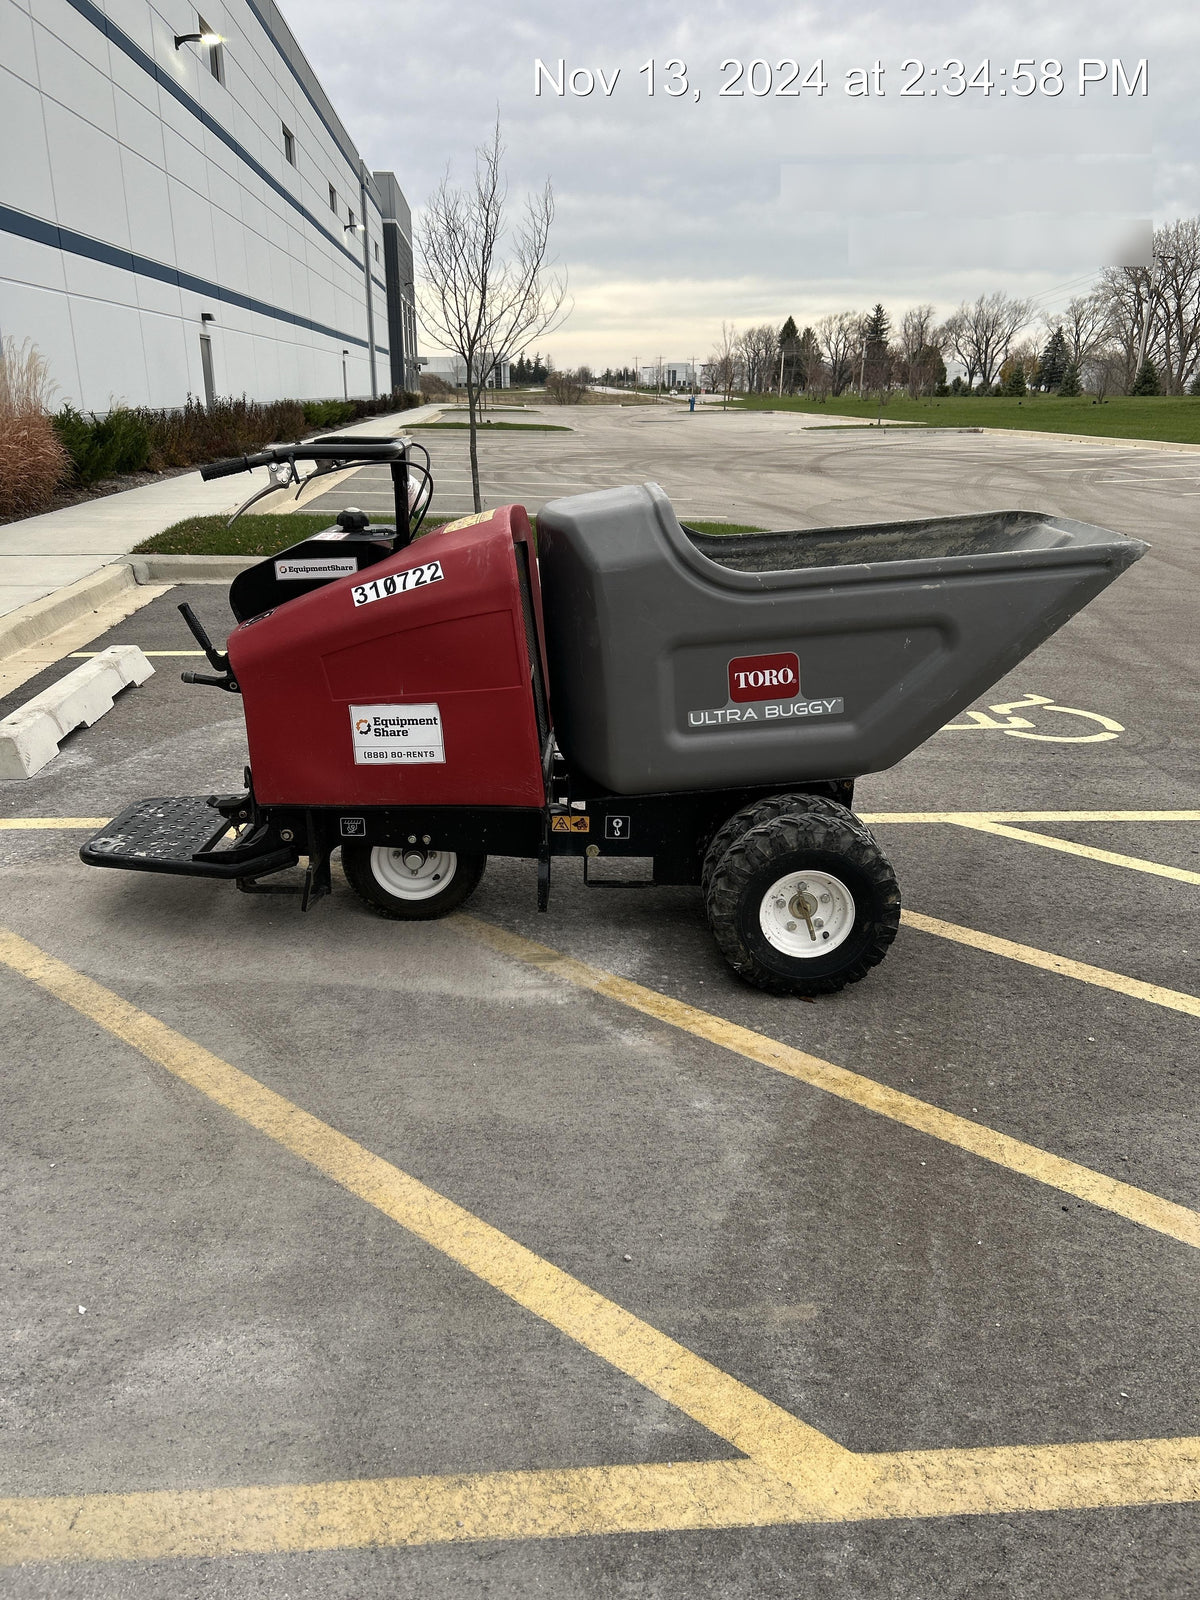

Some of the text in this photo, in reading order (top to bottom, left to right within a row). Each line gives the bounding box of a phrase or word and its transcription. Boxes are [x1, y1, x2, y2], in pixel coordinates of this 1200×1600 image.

[288, 564, 354, 574] EquipmentShare
[353, 562, 443, 605] 310722
[734, 667, 795, 689] TORO
[689, 699, 837, 726] ULTRA BUGGY
[372, 716, 439, 728] Equipment
[373, 727, 409, 738] Share
[363, 750, 435, 759] (888) 80-RENTS
